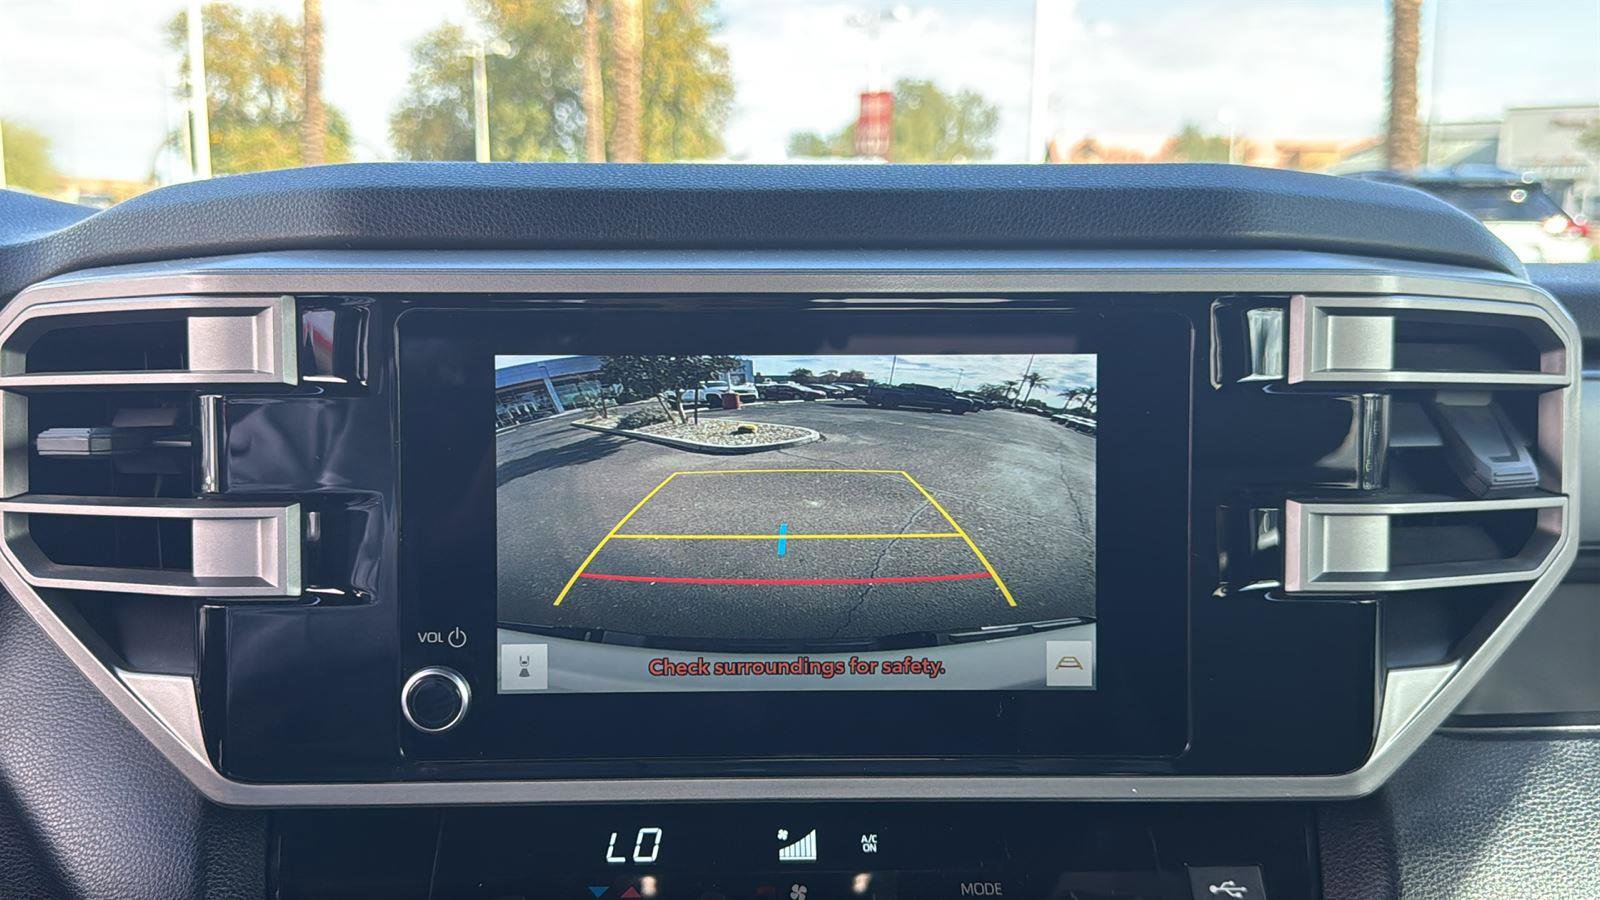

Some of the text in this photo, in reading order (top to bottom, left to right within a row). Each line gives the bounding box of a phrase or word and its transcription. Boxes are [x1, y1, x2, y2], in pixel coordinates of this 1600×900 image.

[417, 631, 444, 643] VOL
[648, 656, 946, 678] Check surroundings for safety.
[606, 828, 662, 863] LO
[861, 834, 878, 844] A/C
[863, 844, 877, 853] ON
[961, 882, 1003, 896] MODE
